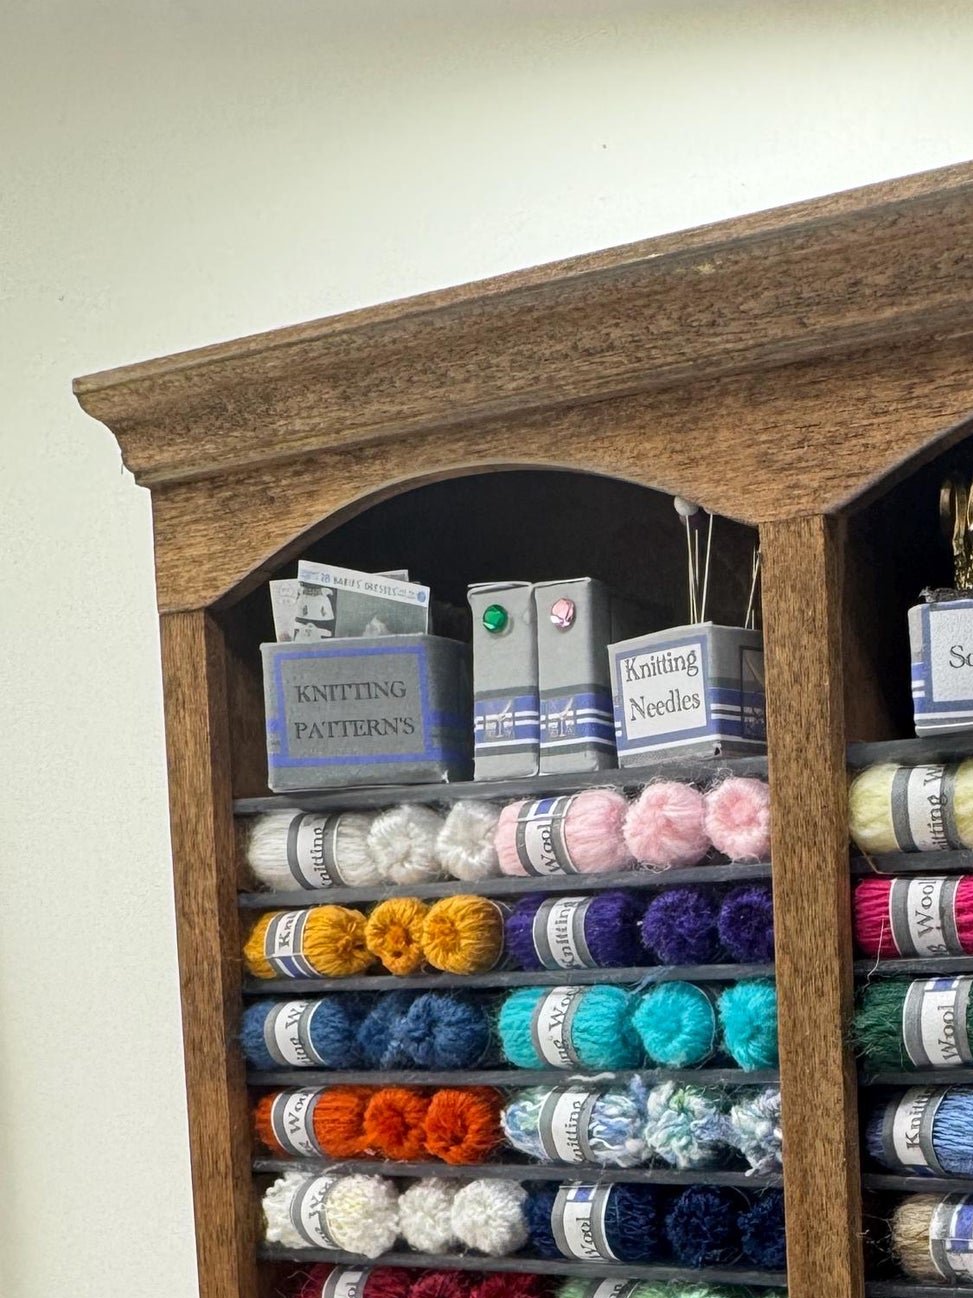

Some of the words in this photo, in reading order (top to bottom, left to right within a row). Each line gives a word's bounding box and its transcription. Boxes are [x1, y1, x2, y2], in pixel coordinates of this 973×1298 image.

[624, 650, 699, 682] Knitting
[294, 680, 407, 703] KNITTING
[629, 688, 701, 722] Needles
[294, 717, 415, 739] PATTERN'S
[927, 791, 949, 851] nitting
[540, 823, 561, 873] Wool
[914, 879, 937, 938] Wool
[938, 1005, 960, 1061] Wool
[575, 1216, 600, 1260] Wool
